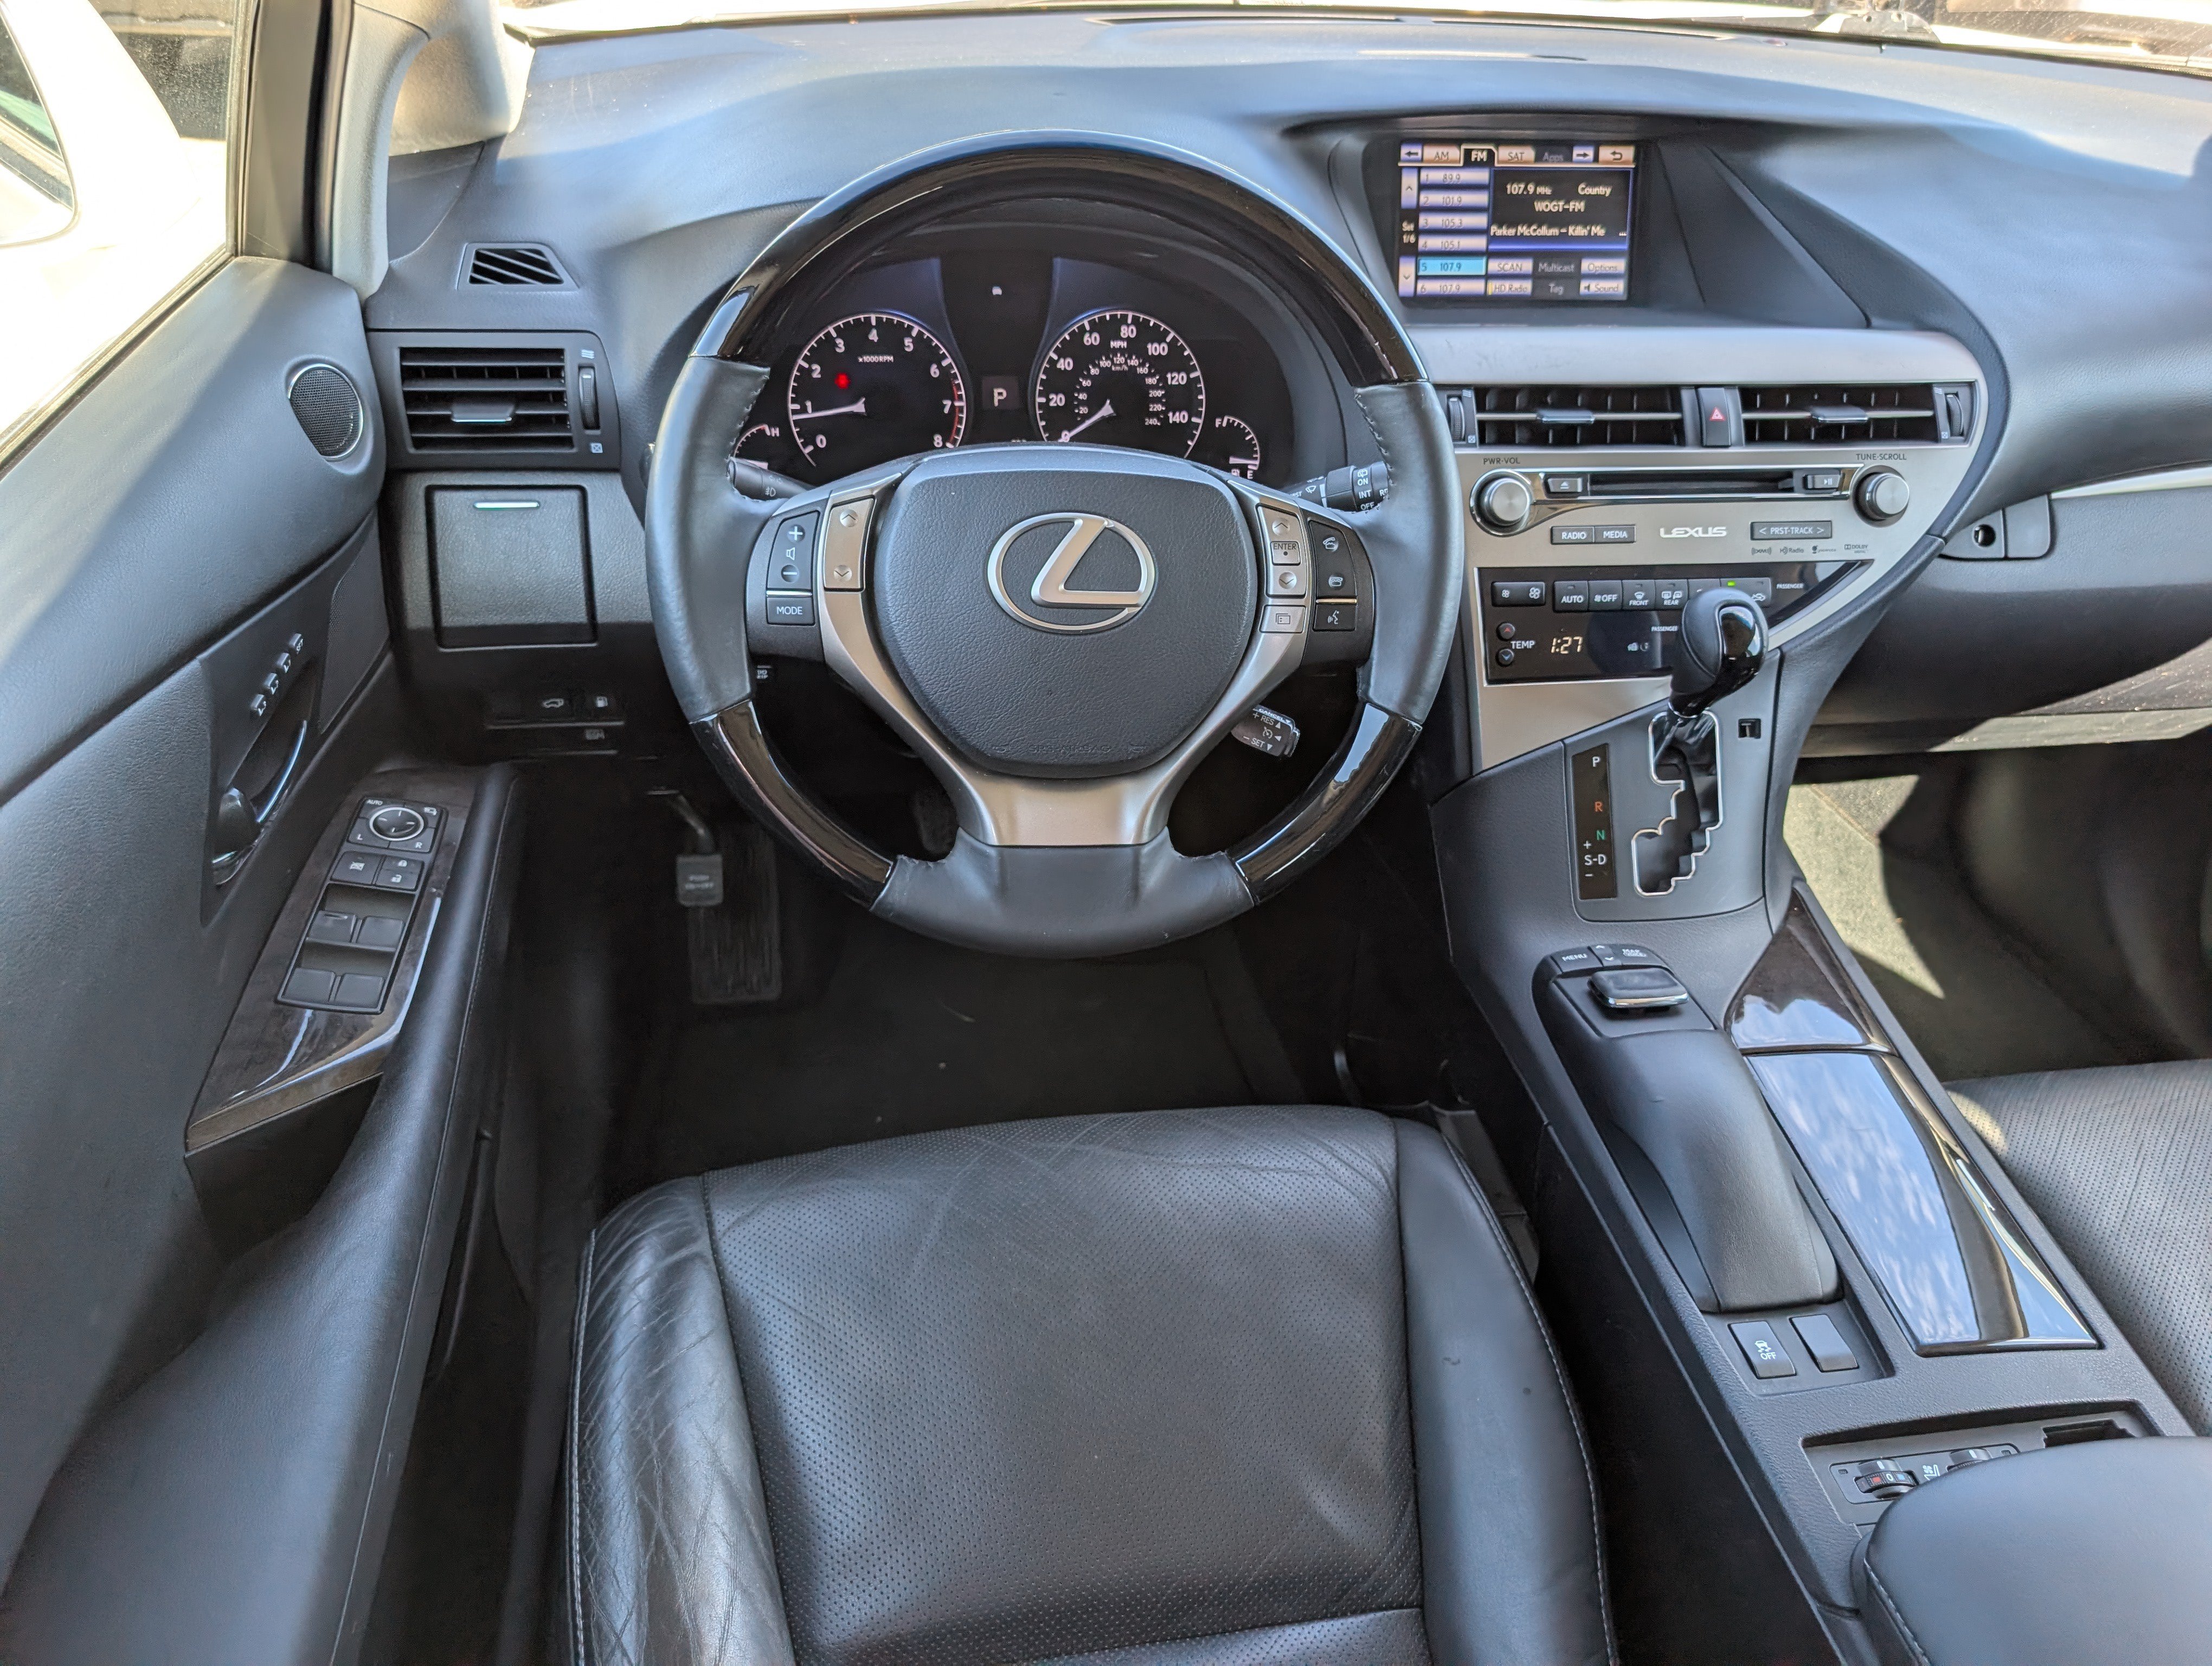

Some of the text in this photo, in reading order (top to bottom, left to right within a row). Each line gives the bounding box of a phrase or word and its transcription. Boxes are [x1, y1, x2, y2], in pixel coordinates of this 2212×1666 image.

[1434, 151, 1449, 161] AM
[1471, 149, 1488, 162] FM
[1508, 151, 1525, 162] SAT
[1507, 182, 1552, 195] 107.9 MHz
[1578, 182, 1613, 197] Country
[1423, 196, 1463, 206] 2 101.9
[1534, 200, 1586, 212] WOGT-FM
[1423, 219, 1463, 229] 3 105.3
[1490, 225, 1516, 237] Parker
[1517, 224, 1560, 237] McCollum
[1591, 225, 1606, 236] Me
[1403, 233, 1417, 244] 1/6
[1422, 241, 1461, 251] 4 105.1
[1421, 262, 1463, 272] 5 107.9
[1497, 262, 1523, 272] SCAN
[1587, 262, 1618, 275] Options
[1420, 284, 1461, 294] 6 107.9
[1494, 284, 1506, 293] HD
[1594, 283, 1619, 293] Sound
[868, 328, 879, 343] 4
[1120, 324, 1137, 338] 80
[903, 337, 914, 352] 5
[1083, 332, 1101, 346] 60
[1110, 340, 1128, 349] MPH
[835, 338, 845, 353] 3
[1147, 342, 1168, 356] 100
[1057, 357, 1073, 371] 40
[1099, 360, 1112, 368] 100
[1127, 358, 1139, 367] 140
[811, 363, 822, 378] 2
[930, 363, 940, 378] 6
[1166, 371, 1187, 385] 120
[993, 387, 1007, 407] P
[1148, 389, 1162, 398] 200
[1049, 393, 1066, 407] 20
[805, 400, 812, 414] 1
[943, 399, 952, 414] 7
[1167, 411, 1189, 424] 140
[1215, 417, 1223, 428] F
[770, 427, 780, 437] H
[815, 434, 827, 448] 0
[933, 434, 943, 448] 8
[1247, 469, 1253, 479] E
[1357, 478, 1368, 486] ON
[1358, 489, 1372, 499] INT
[1360, 501, 1375, 511] OFF
[1561, 531, 1587, 540] RADIO
[1603, 530, 1628, 539] MEDIA
[1660, 526, 1727, 538] LEXUS
[1273, 542, 1297, 550] ENTER
[1561, 595, 1584, 604] AUTO
[1601, 593, 1618, 603] OFF
[776, 606, 803, 616] MODE
[1510, 640, 1535, 649] TEMP
[1551, 636, 1584, 655] 1:27
[1259, 708, 1286, 722] CANCEL
[1261, 714, 1275, 726] RES
[1251, 737, 1265, 748] SET
[1592, 756, 1601, 767] P
[1594, 800, 1603, 812] R
[357, 833, 364, 841] L
[1596, 829, 1606, 841] N
[415, 841, 423, 849] R
[1561, 952, 1588, 962] MENU
[1760, 1351, 1777, 1360] OFF
